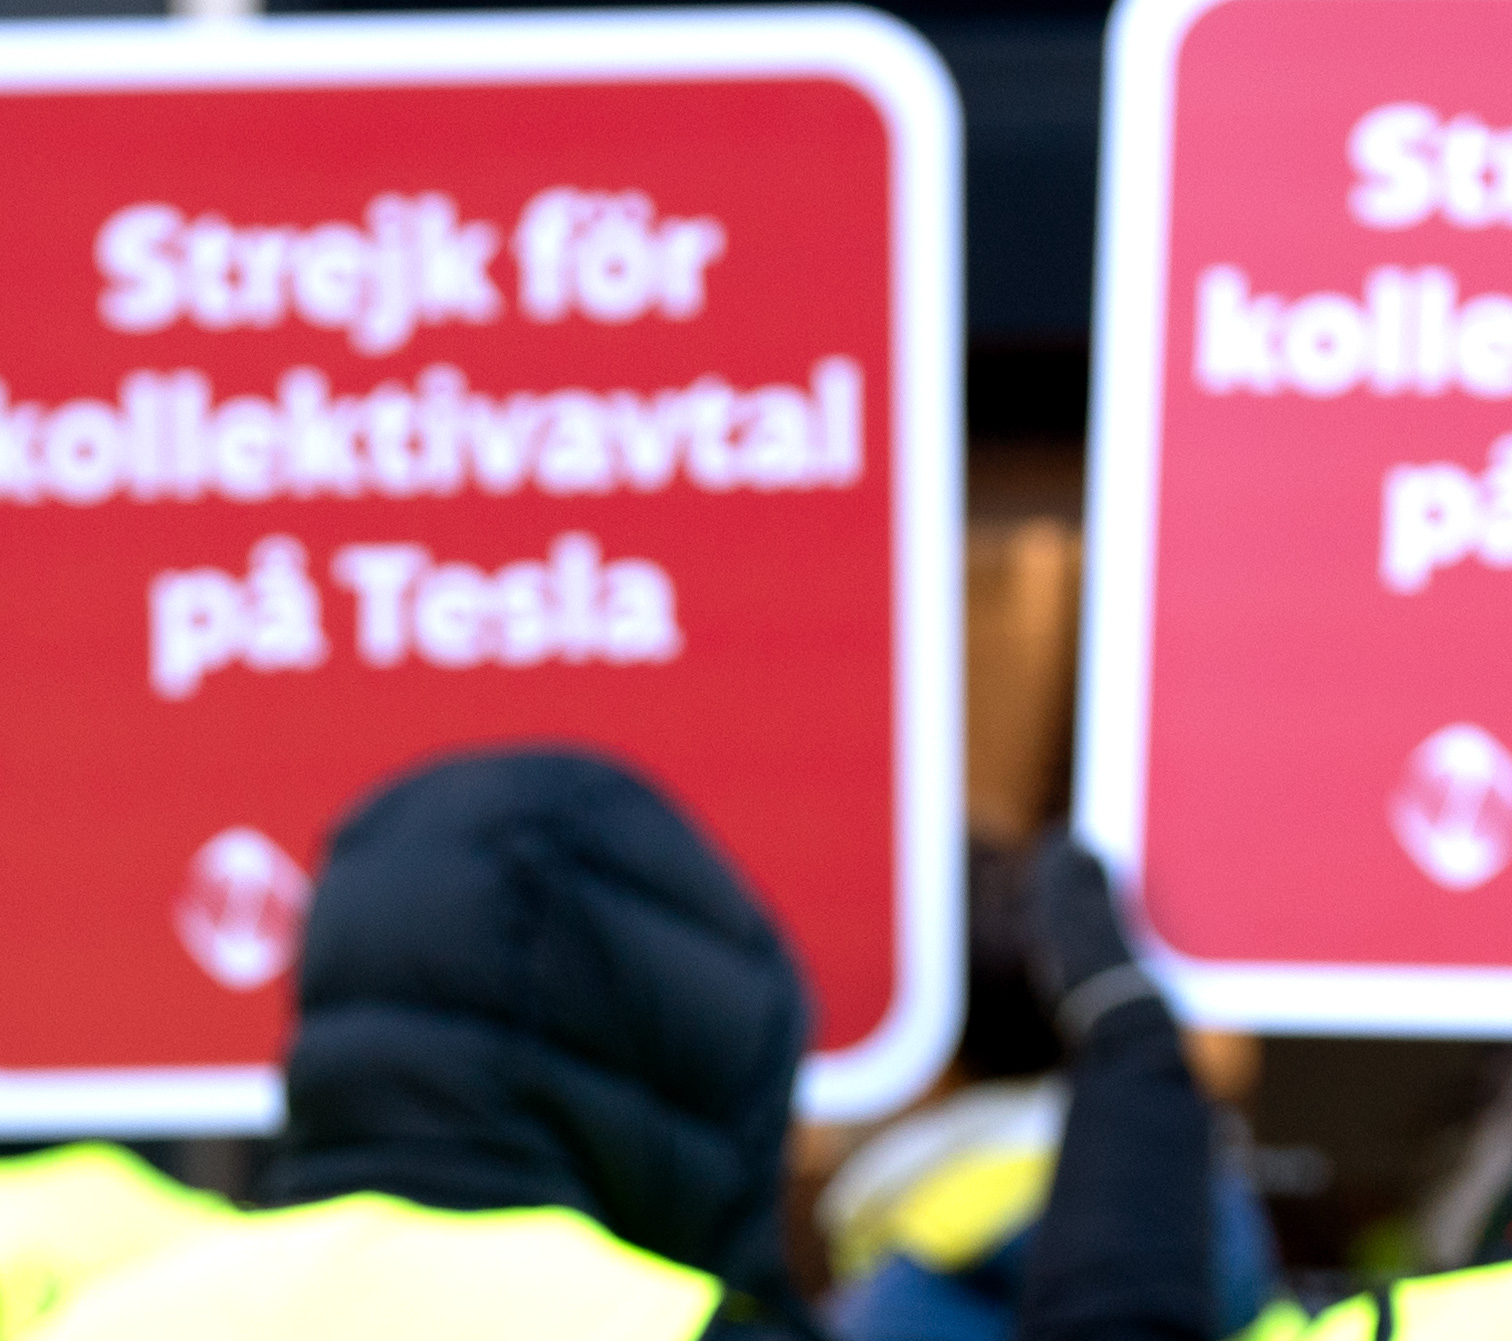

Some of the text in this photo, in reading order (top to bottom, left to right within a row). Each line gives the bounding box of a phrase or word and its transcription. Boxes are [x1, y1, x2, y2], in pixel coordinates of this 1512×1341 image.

[94, 186, 726, 356] Strejk för
[148, 532, 682, 700] på Tesla
